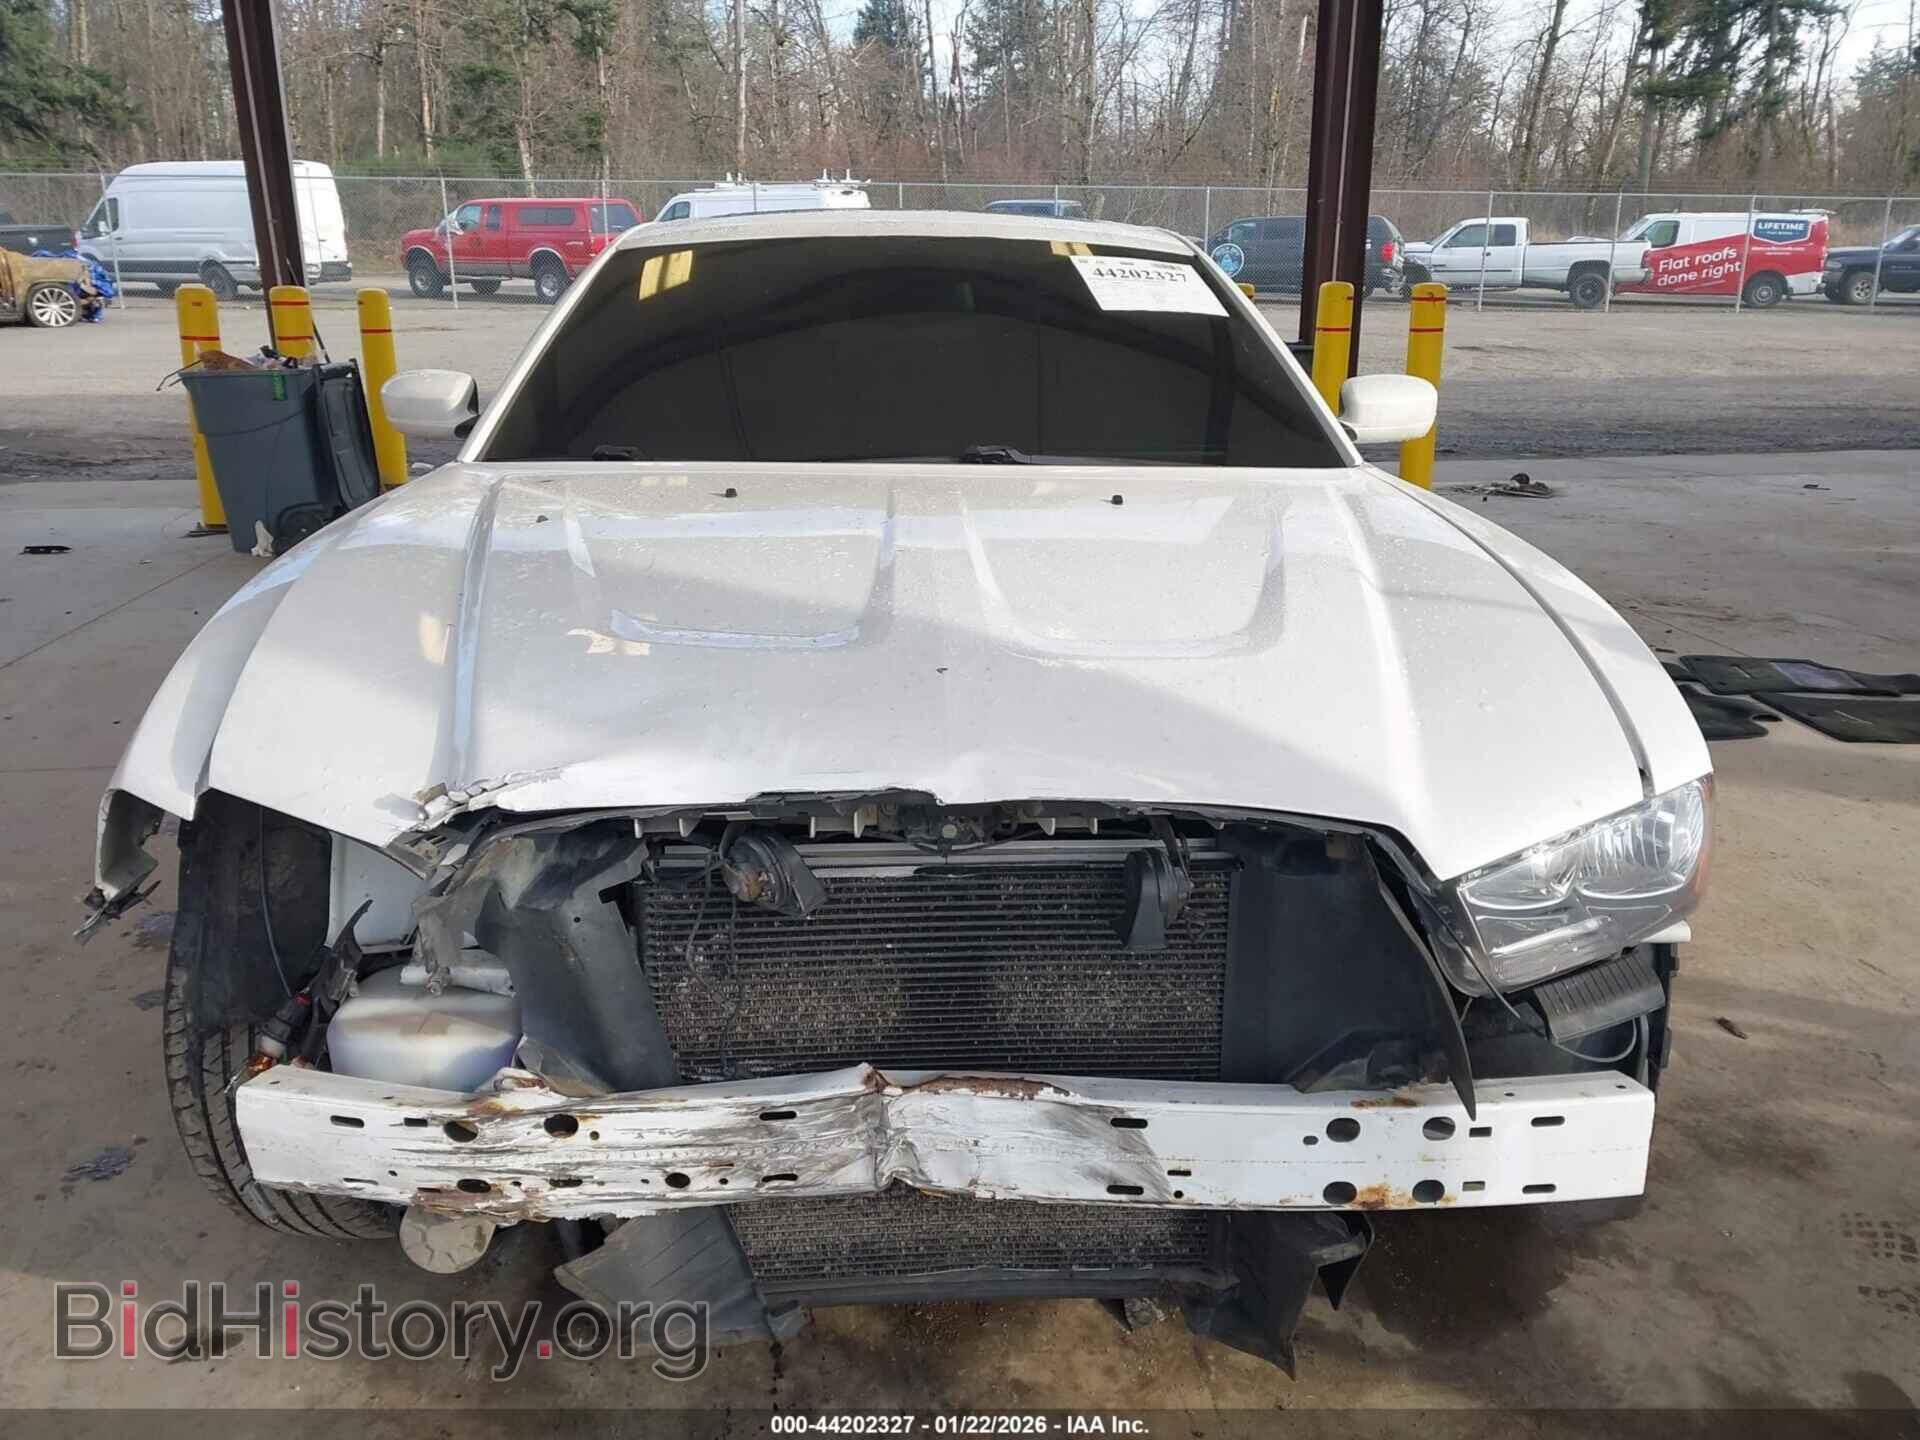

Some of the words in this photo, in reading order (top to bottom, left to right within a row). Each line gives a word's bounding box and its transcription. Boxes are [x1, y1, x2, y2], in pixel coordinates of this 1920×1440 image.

[1758, 222, 1806, 231] LIFETIME
[1658, 256, 1691, 273] Flat
[1695, 246, 1738, 265] roofs
[1092, 267, 1187, 283] 44202327
[1657, 271, 1698, 287] done
[1701, 261, 1742, 279] right
